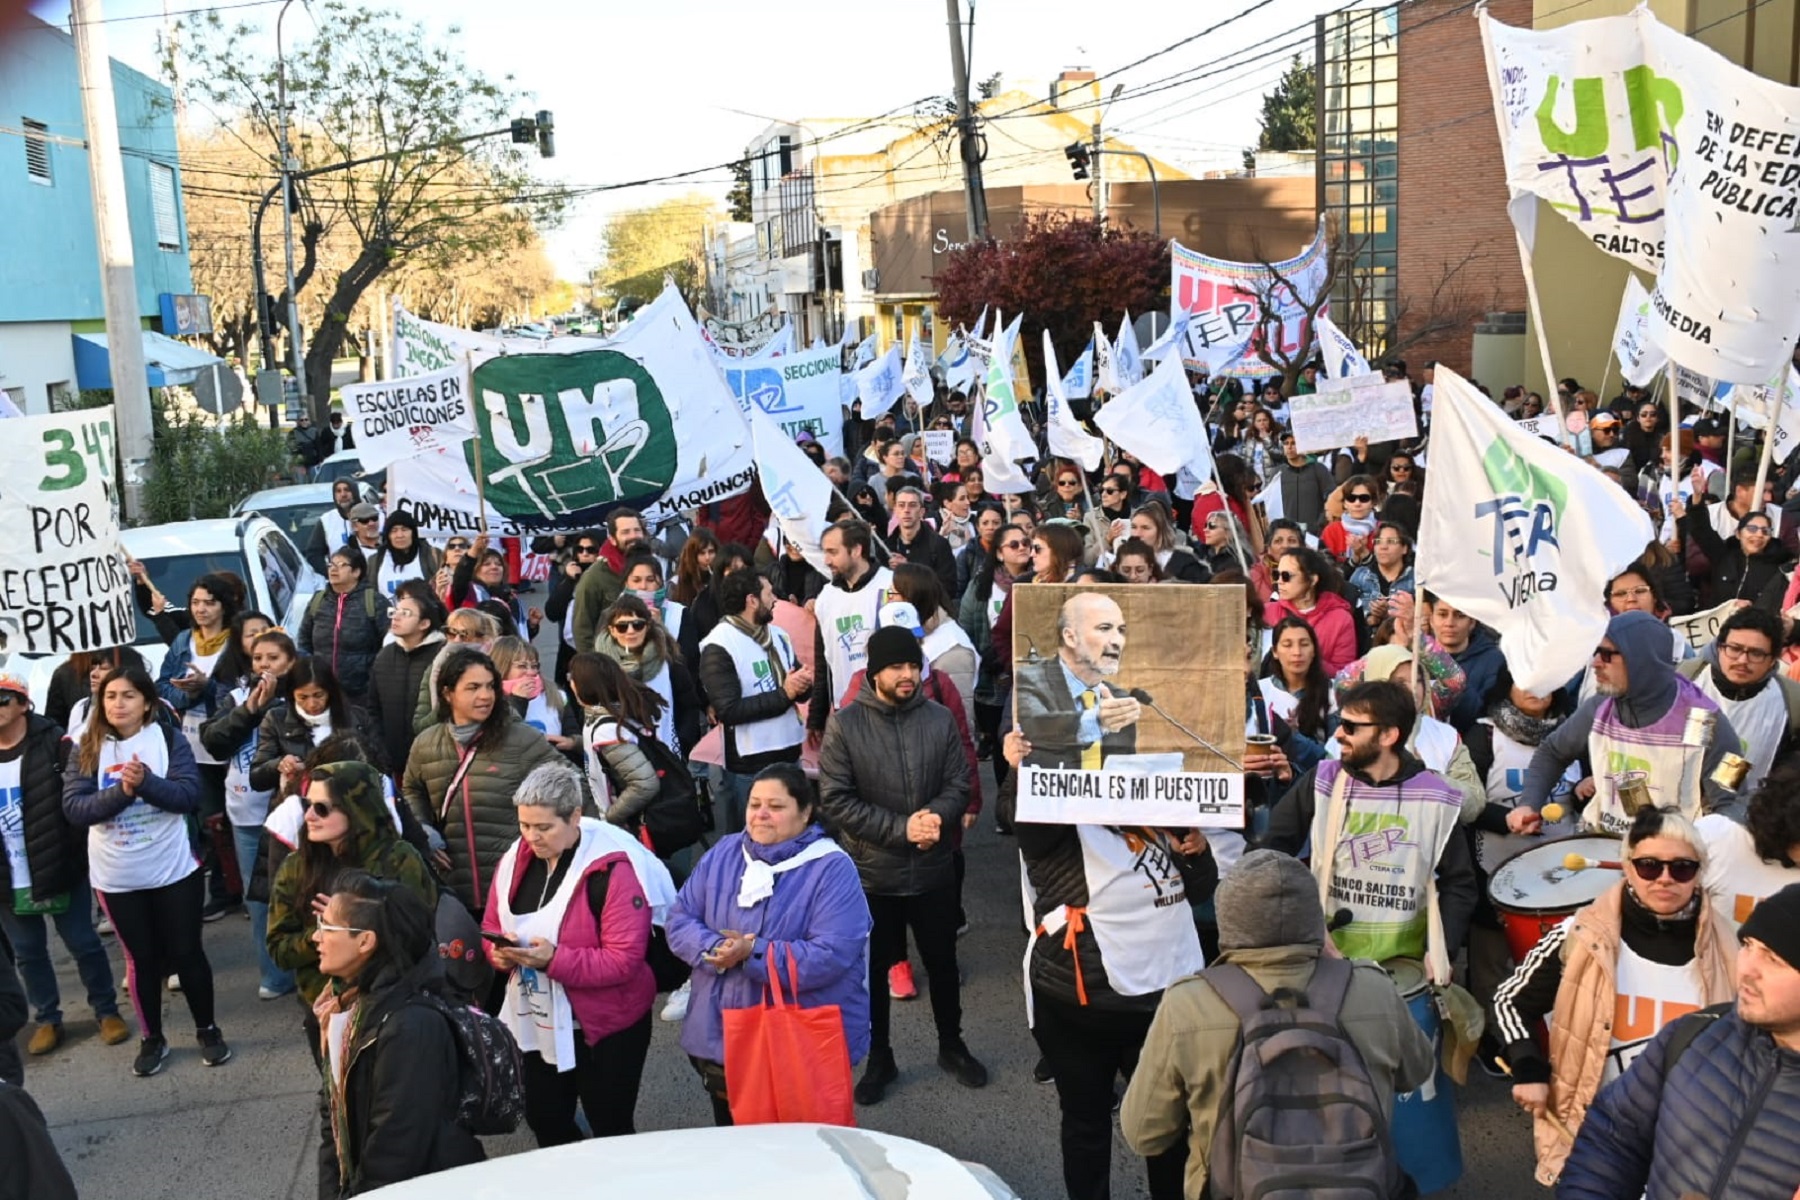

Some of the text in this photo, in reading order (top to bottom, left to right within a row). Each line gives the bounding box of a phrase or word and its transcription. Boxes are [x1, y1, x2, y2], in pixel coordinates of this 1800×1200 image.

[1729, 121, 1800, 159] DEFE
[1695, 135, 1800, 188] DE LA ED
[1699, 170, 1798, 219] PÚBLICA
[356, 377, 461, 414] ESCUELAS EN
[363, 399, 466, 438] CONDICIONES
[32, 502, 97, 553] POR
[1031, 771, 1229, 804] ESENCIAL ES MI PUESTITO
[1365, 882, 1407, 898] SALTOS
[1408, 886, 1416, 899] Y
